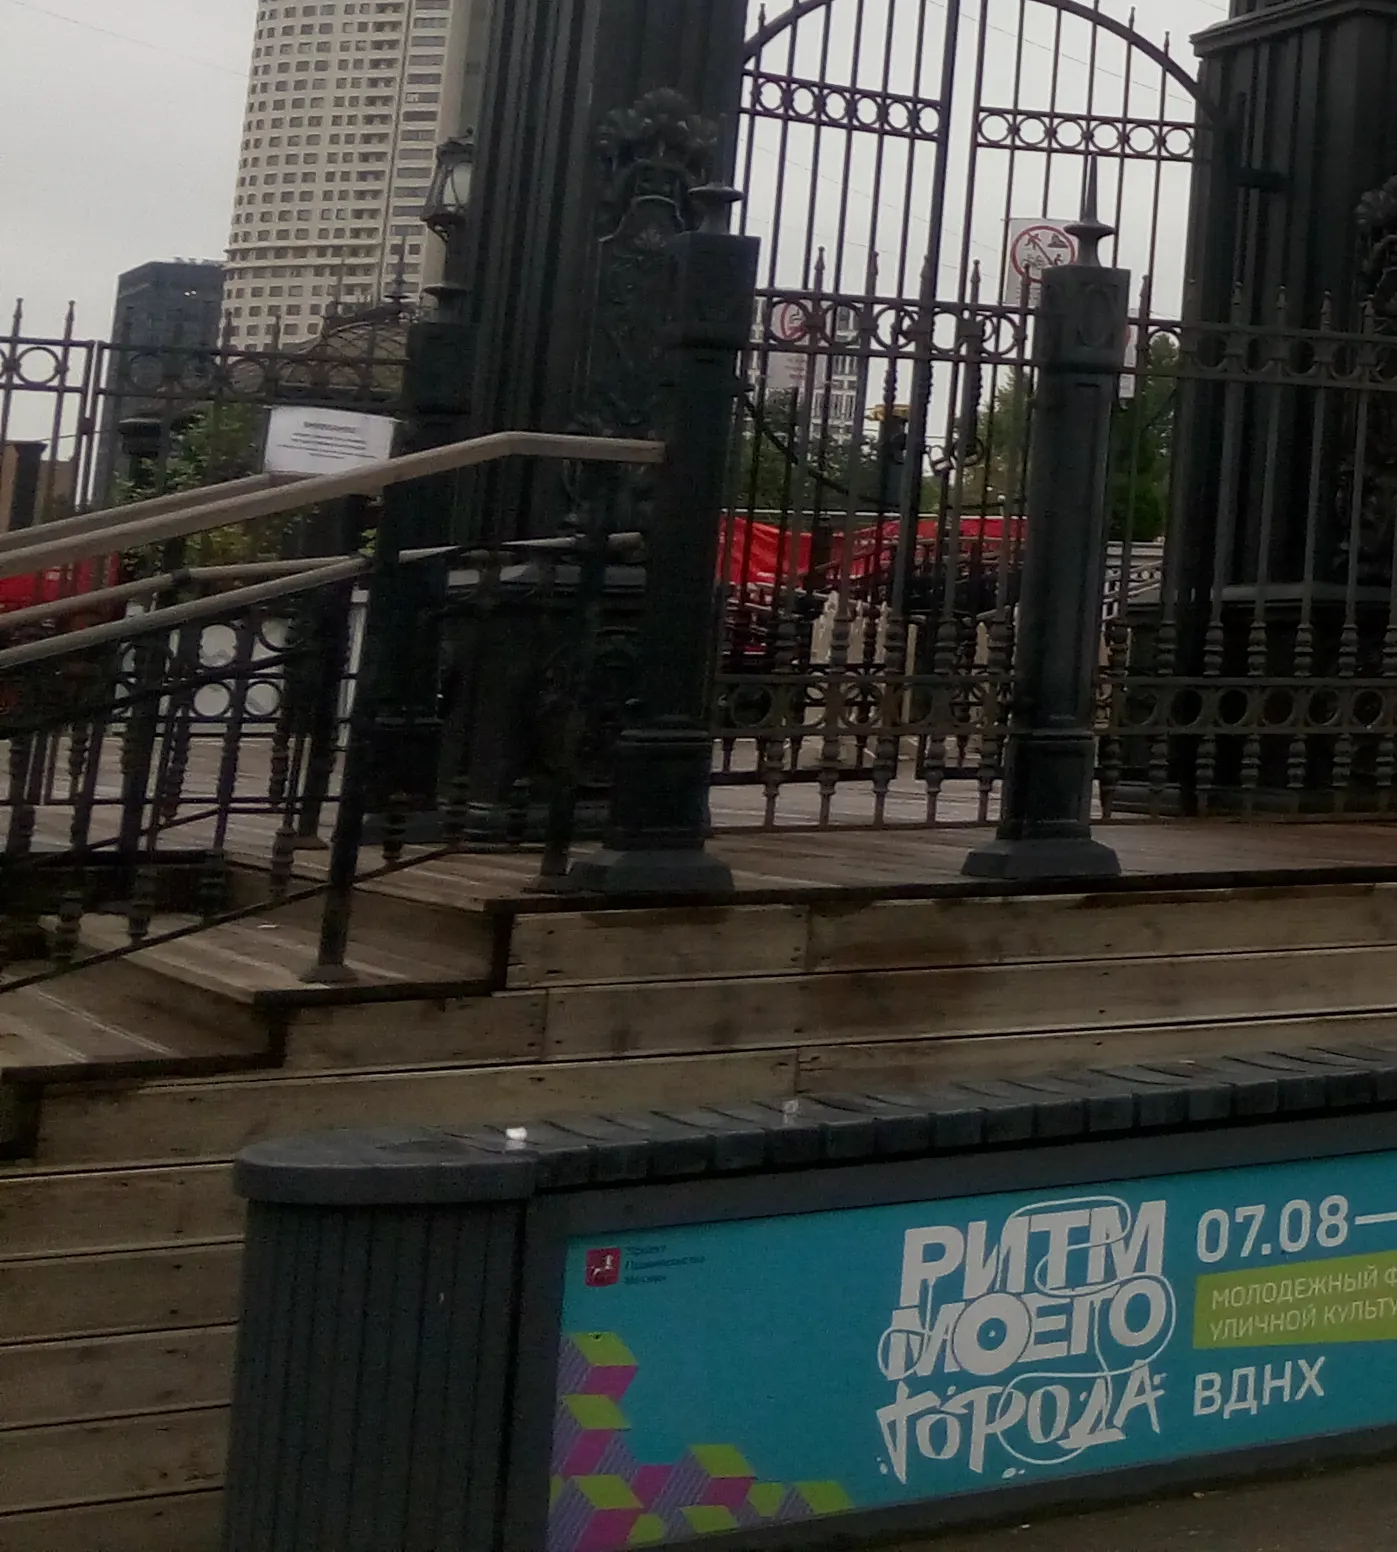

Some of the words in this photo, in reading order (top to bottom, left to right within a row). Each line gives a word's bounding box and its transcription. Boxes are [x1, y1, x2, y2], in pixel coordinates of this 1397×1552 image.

[899, 1198, 1167, 1300] РИТМ
[1211, 1265, 1378, 1310] МОЛОДЕЖНЫЙ
[880, 1274, 1175, 1380] МОЕГО
[1208, 1304, 1316, 1341] УЛИЧНОЙ
[1194, 1355, 1326, 1419] ВДНХ
